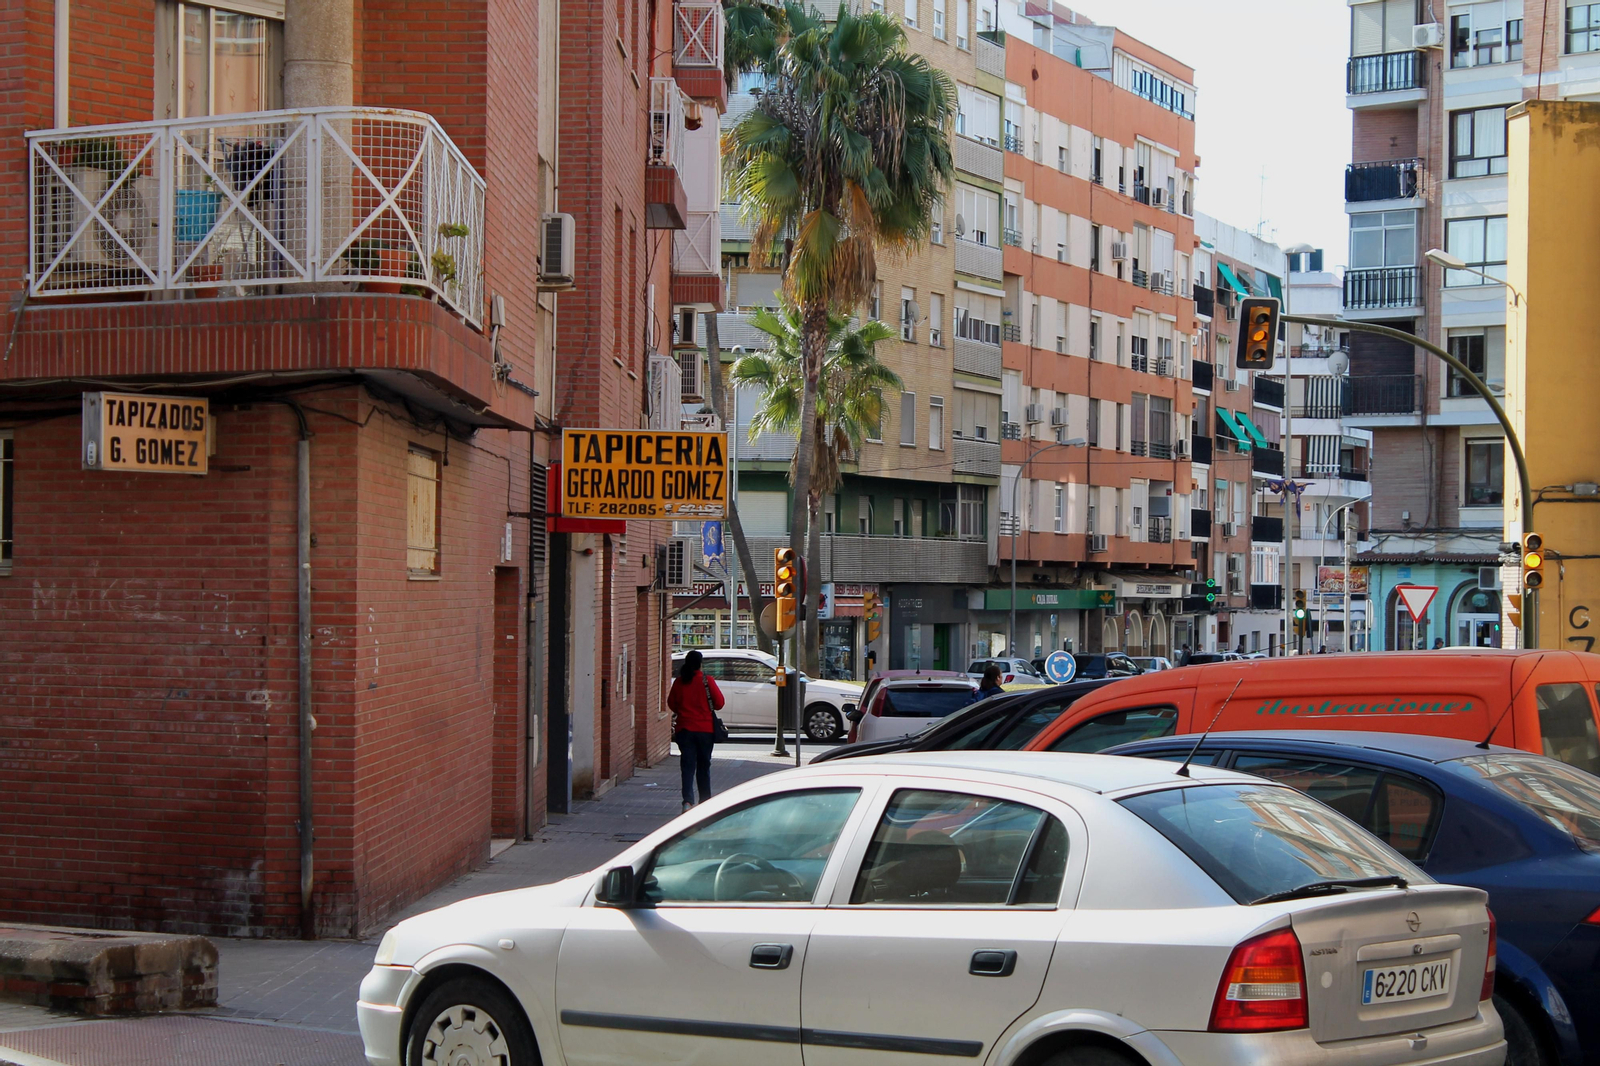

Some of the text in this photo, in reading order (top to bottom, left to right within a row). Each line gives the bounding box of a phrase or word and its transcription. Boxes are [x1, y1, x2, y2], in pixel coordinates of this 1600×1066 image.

[106, 399, 204, 431] TAPIZADOS
[110, 436, 126, 464] G.
[136, 438, 198, 466] GOMEZ
[568, 433, 723, 466] TAPICERIA
[567, 468, 723, 500] GERARDO GOMEZ
[567, 502, 595, 514] TLF:
[1256, 697, 1474, 715] ilustraciones
[1309, 947, 1339, 957] ASTRA
[1375, 963, 1448, 998] 6220 CKV
